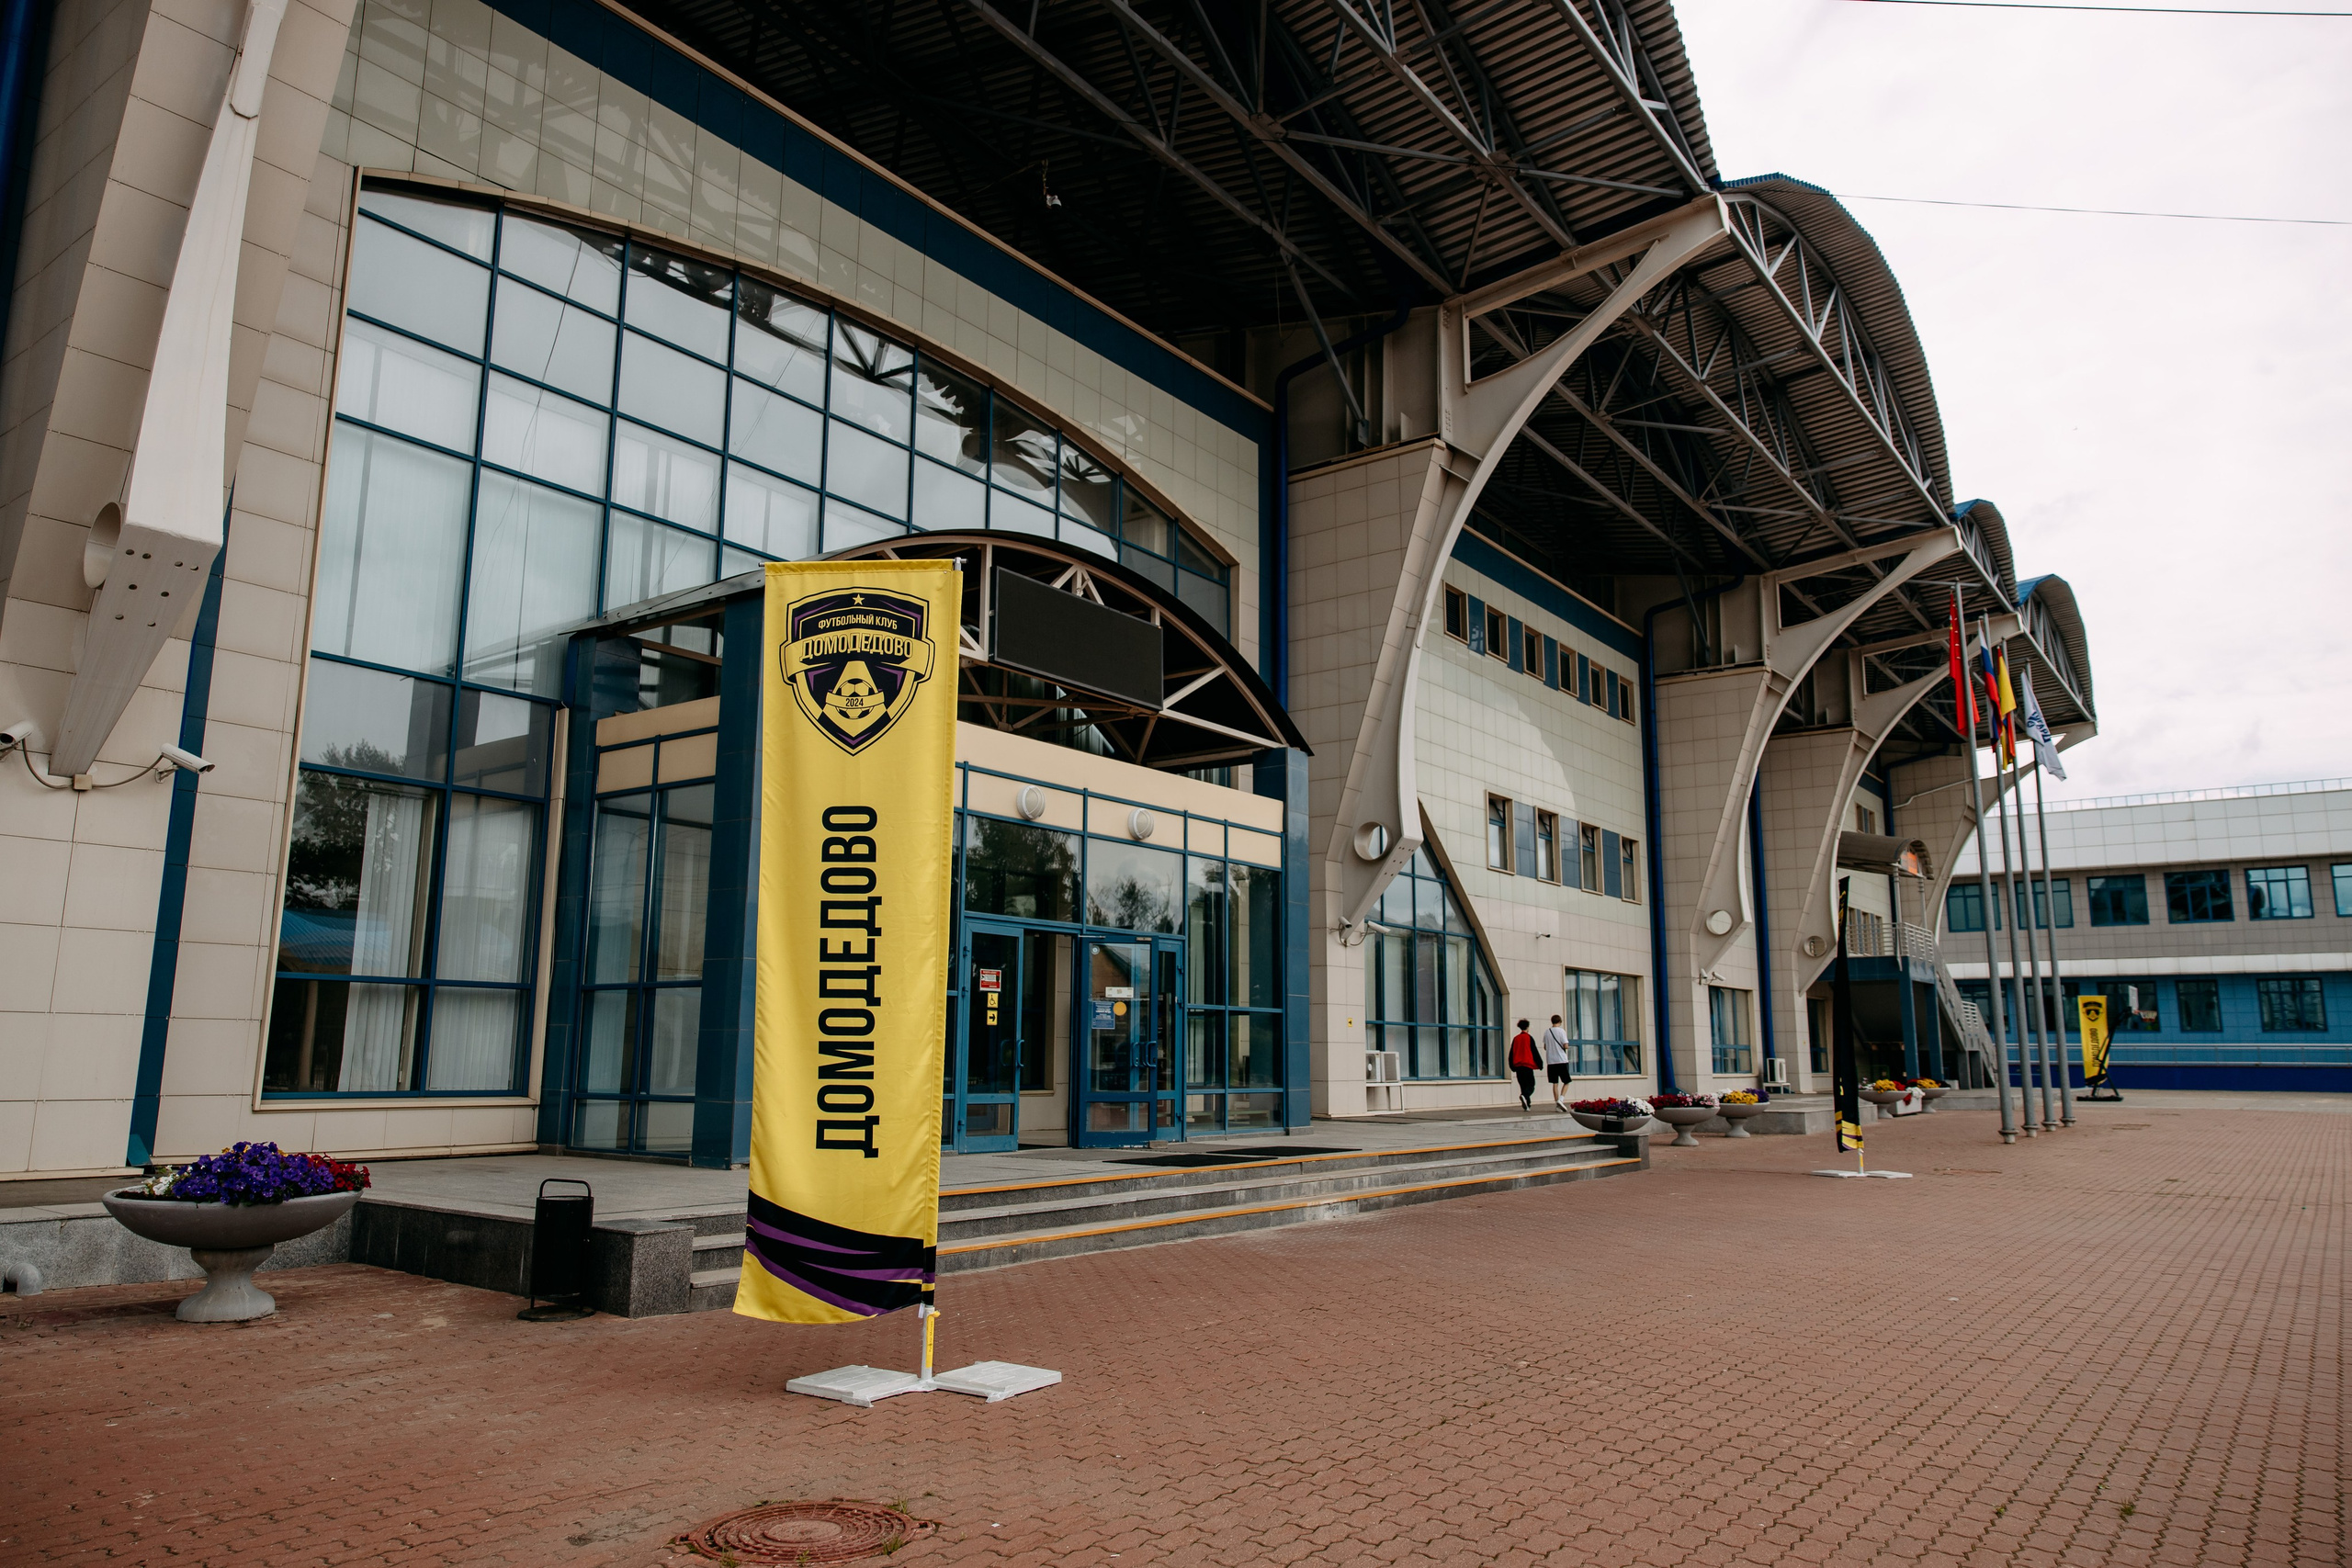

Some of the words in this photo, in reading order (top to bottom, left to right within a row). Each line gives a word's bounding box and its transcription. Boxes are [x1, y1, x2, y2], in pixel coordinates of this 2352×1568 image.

[818, 614, 874, 629] ФУТБОЛЬНЫЙ
[876, 615, 898, 630] КЛУБ
[799, 632, 913, 661] ДОМОДЕДОВО
[845, 698, 864, 706] 2024
[816, 805, 882, 1158] ДОМОДЕДОВО
